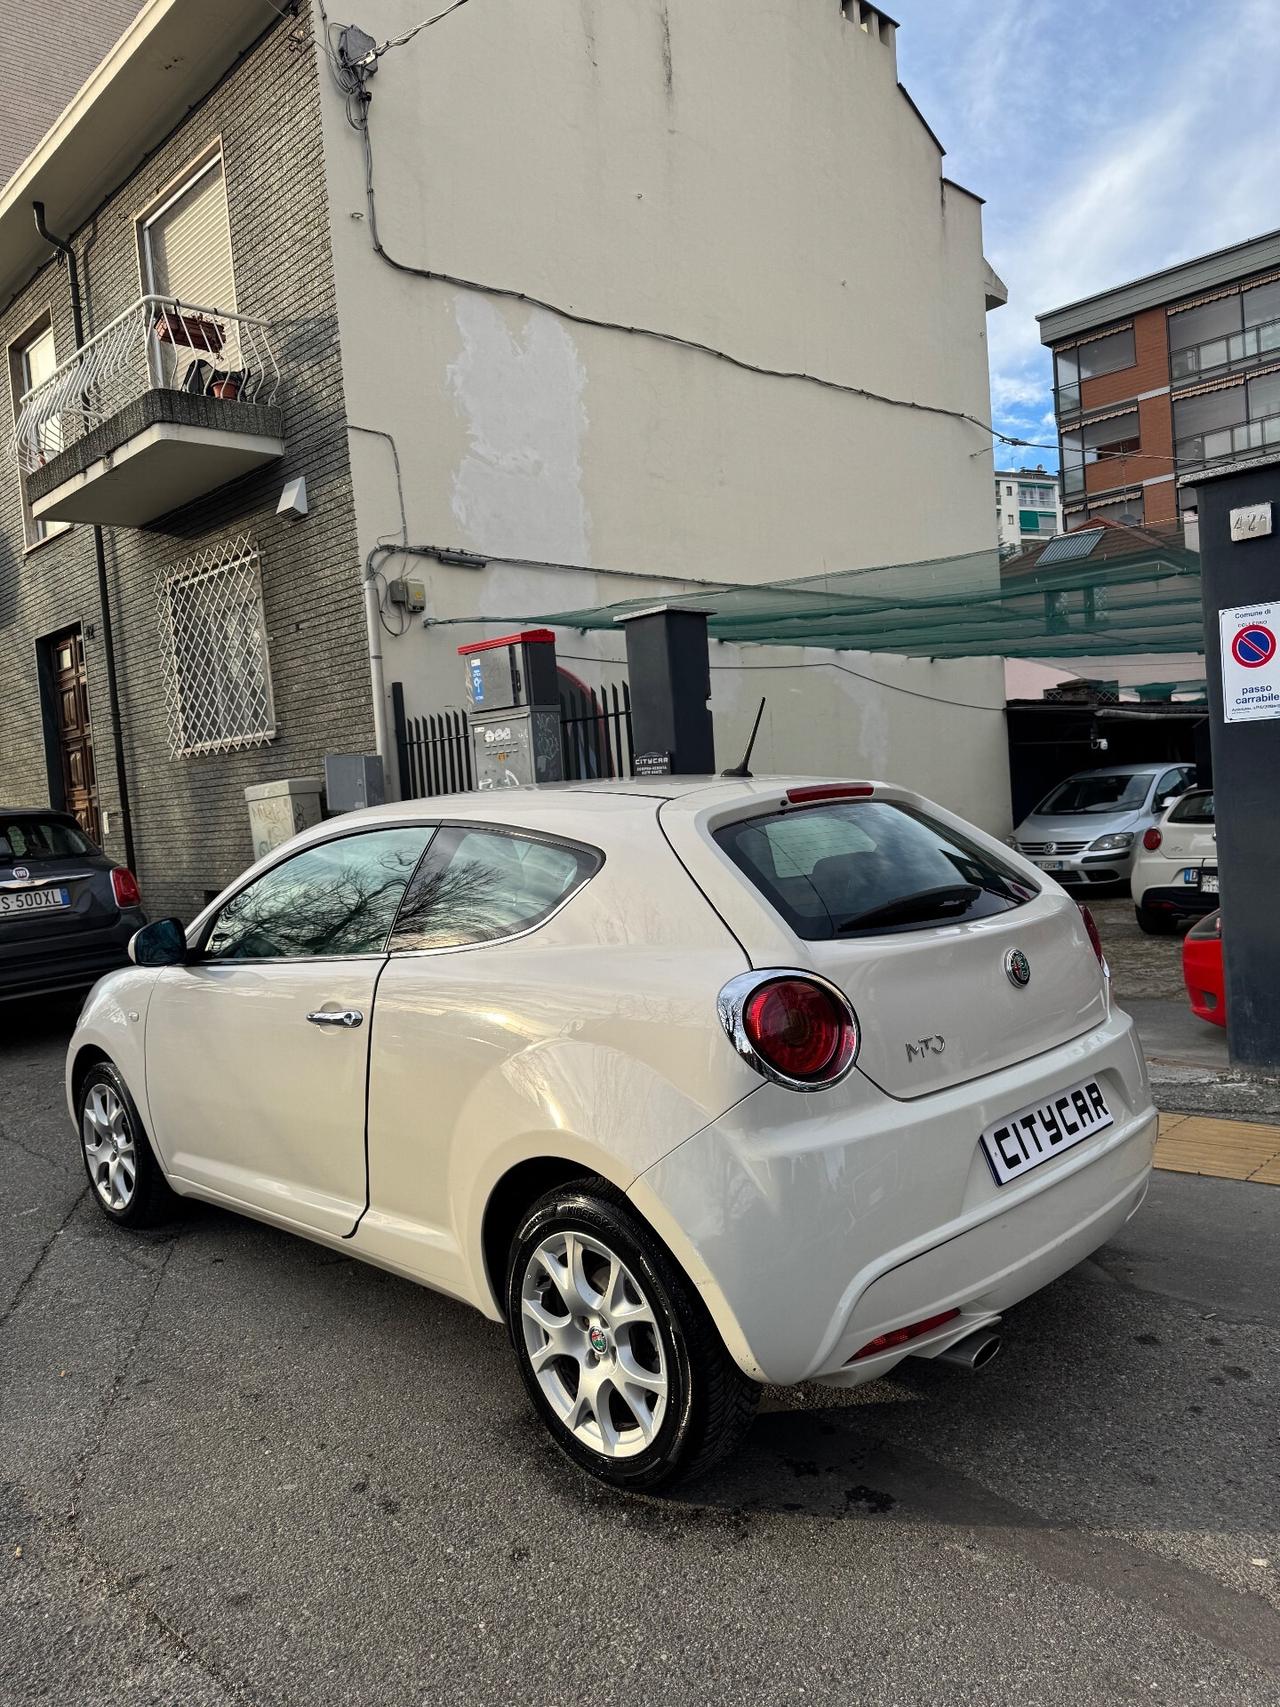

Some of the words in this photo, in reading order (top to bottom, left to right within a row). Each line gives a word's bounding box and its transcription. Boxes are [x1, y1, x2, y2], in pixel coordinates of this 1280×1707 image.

[1235, 611, 1263, 619] Comune
[1242, 685, 1272, 695] passo
[1235, 693, 1280, 704] carrabile
[635, 757, 669, 765] CITYCAR
[994, 1082, 1109, 1169] CITYCAR
